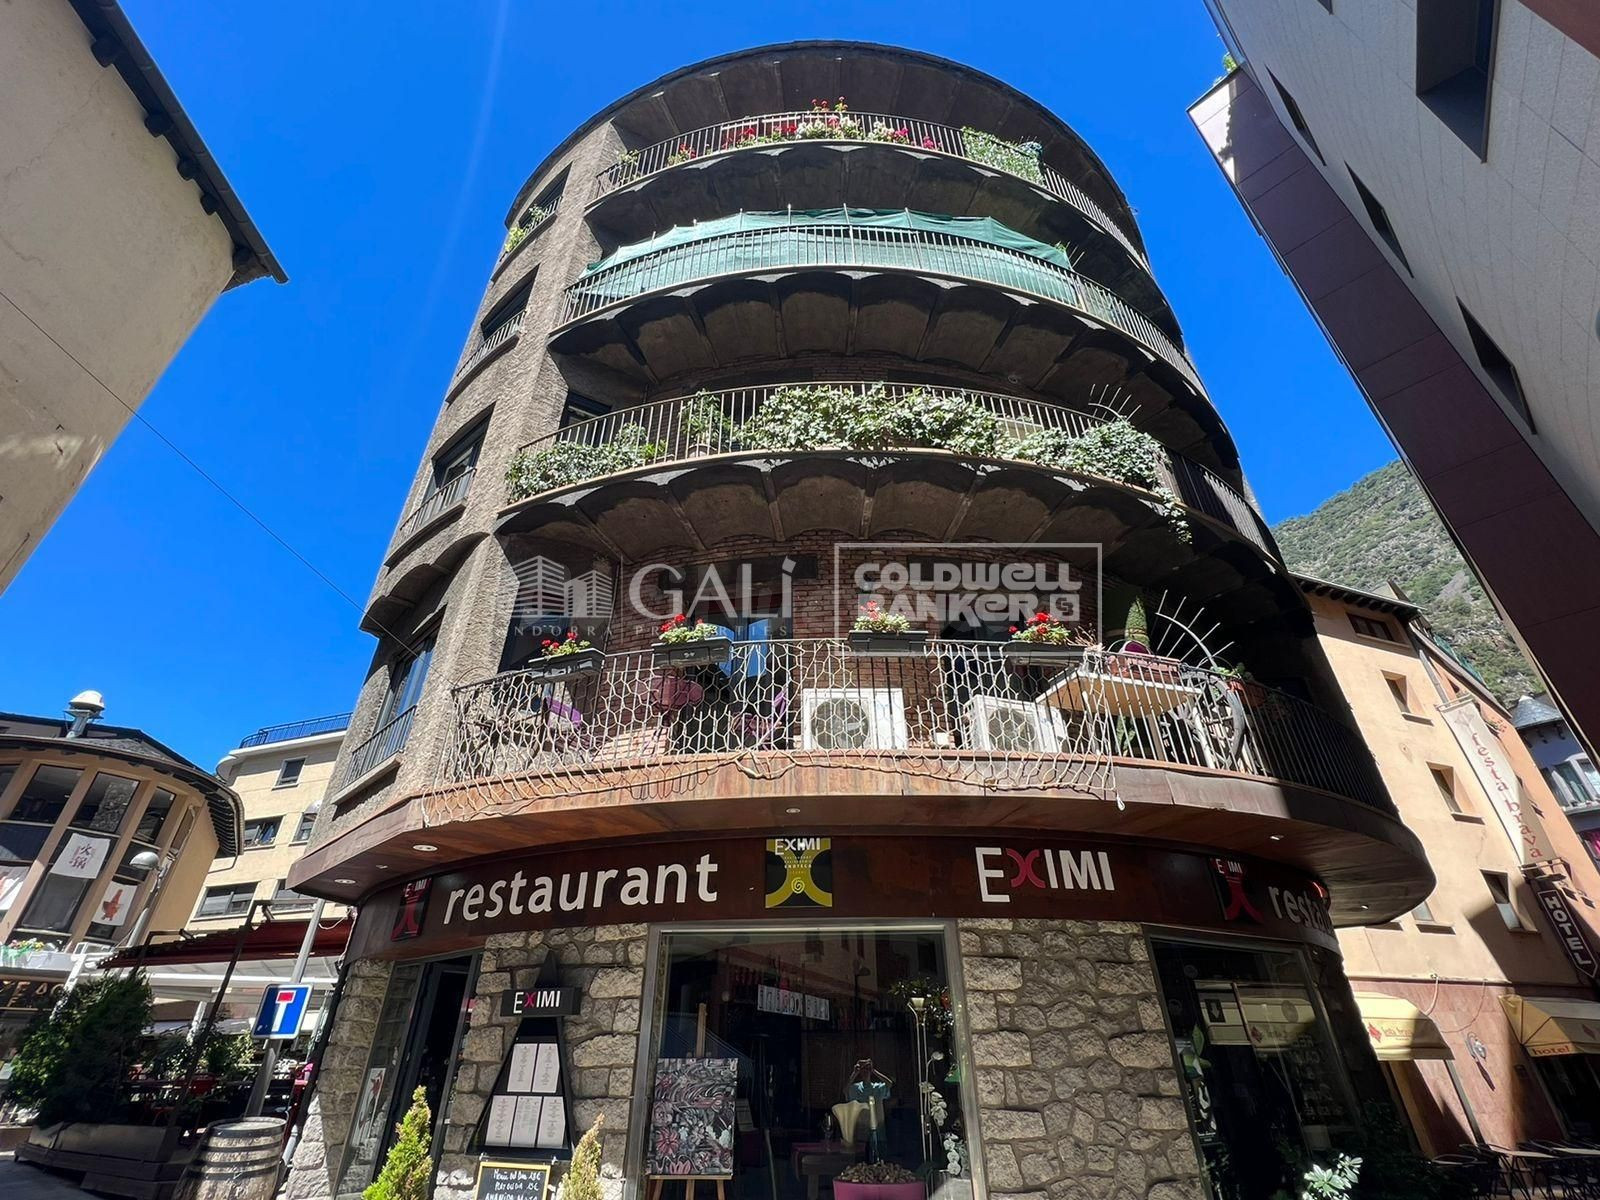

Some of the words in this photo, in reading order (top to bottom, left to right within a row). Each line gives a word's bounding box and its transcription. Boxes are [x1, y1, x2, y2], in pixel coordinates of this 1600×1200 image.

[1504, 798, 1544, 858] brava
[774, 837, 821, 856] EXIMI
[975, 846, 1115, 903] EXIMI
[1215, 858, 1243, 875] EIMI
[404, 878, 430, 898] EIMI
[443, 853, 719, 926] restaurant
[1544, 895, 1592, 965] HOTEL
[513, 990, 561, 1014] EXIMI
[1531, 1045, 1570, 1056] hotel
